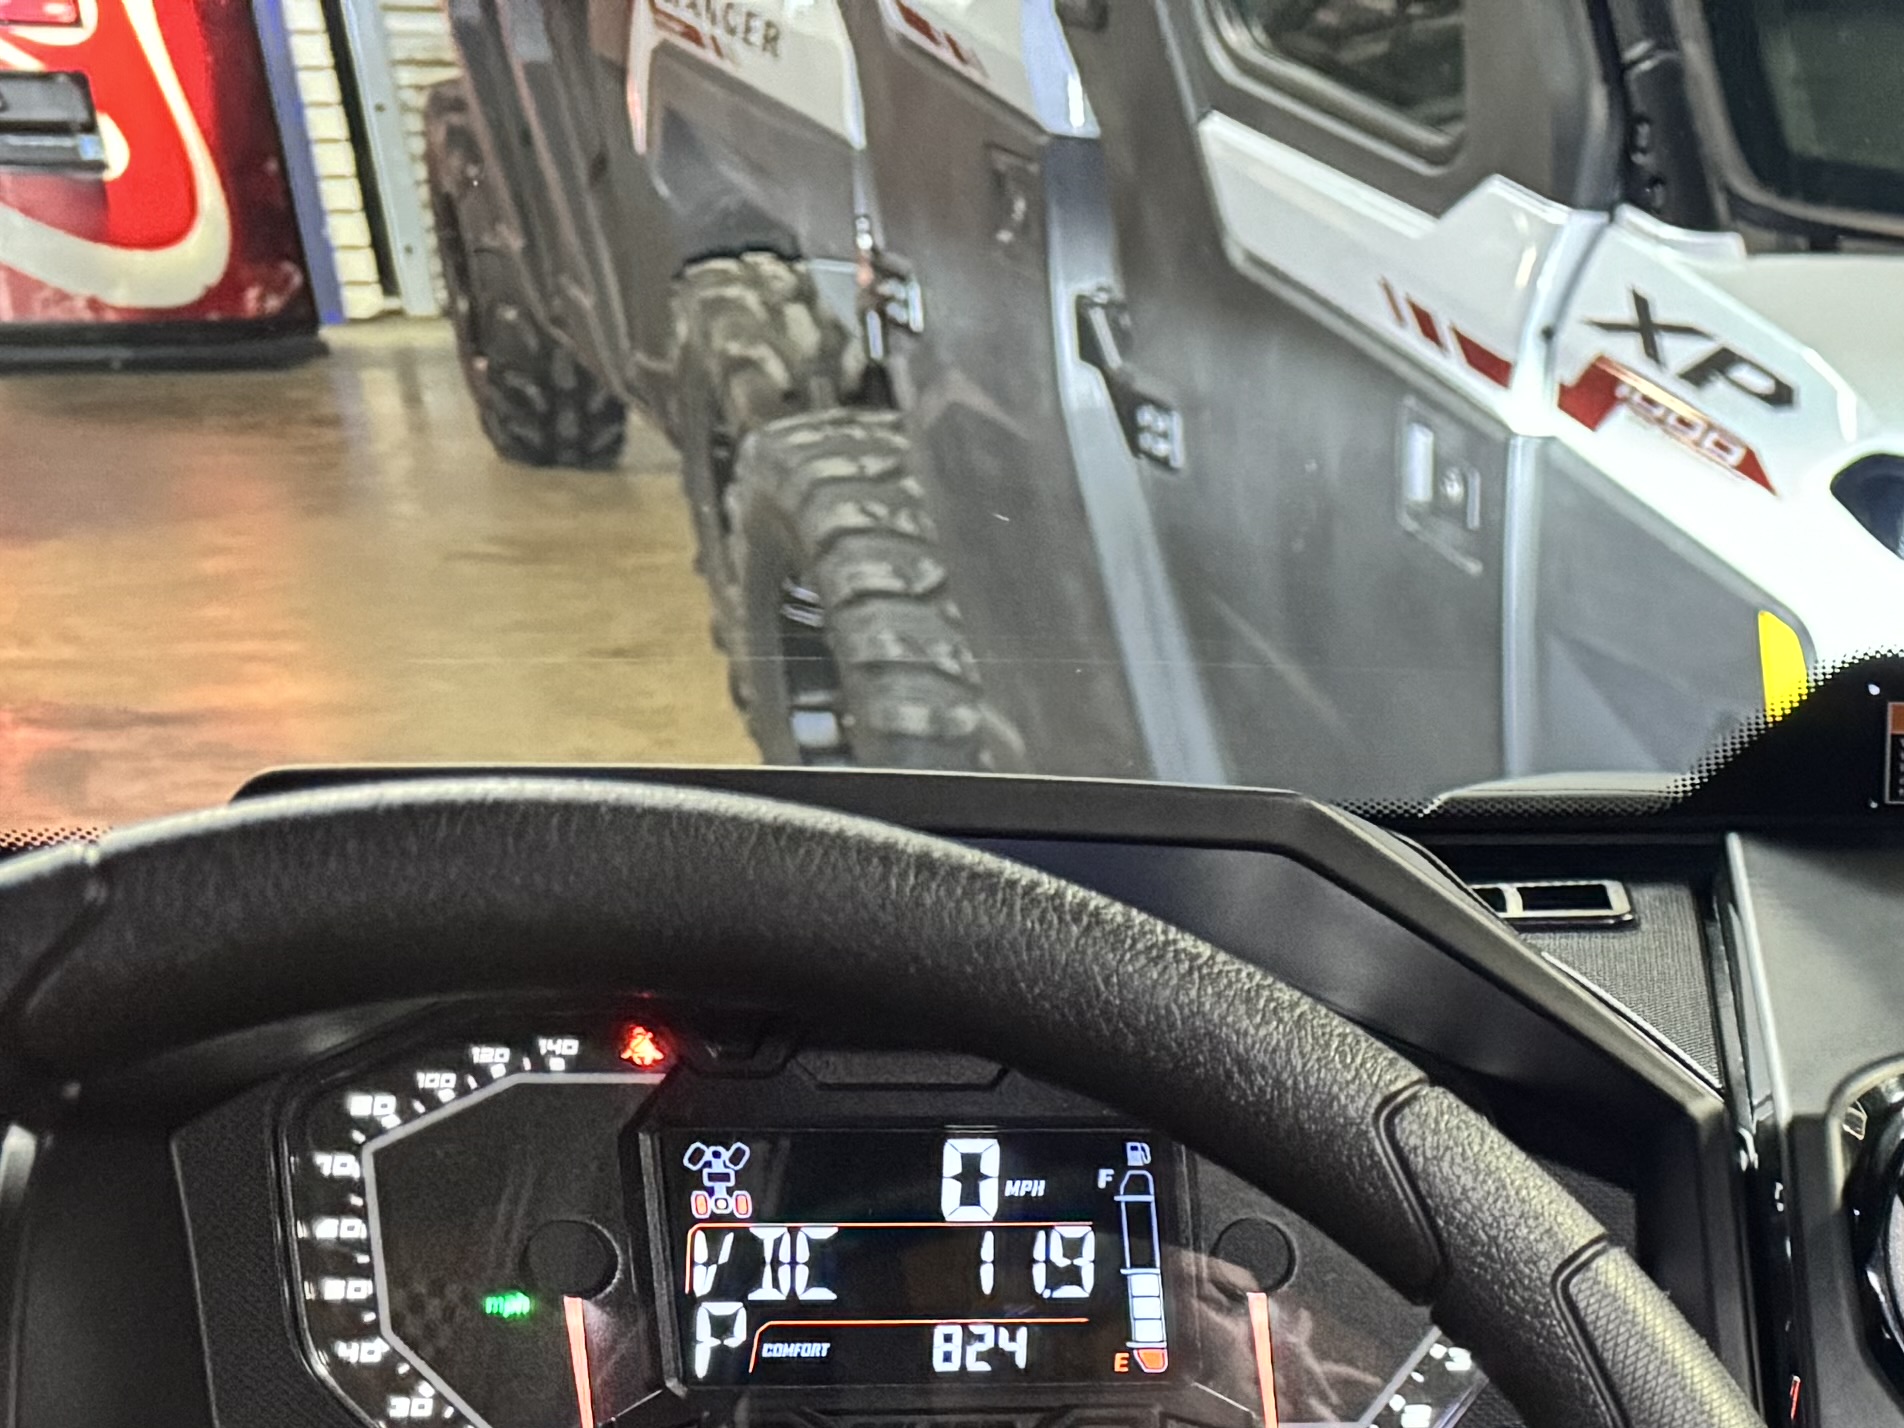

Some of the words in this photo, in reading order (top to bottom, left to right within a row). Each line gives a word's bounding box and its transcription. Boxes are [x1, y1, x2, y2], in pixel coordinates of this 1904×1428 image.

[1583, 284, 1797, 411] XP
[471, 1046, 510, 1064] 120
[538, 1038, 579, 1056] 140
[416, 1072, 457, 1089] 100
[942, 1137, 1000, 1222] 0
[1005, 1179, 1046, 1197] MPH
[1097, 1169, 1115, 1189] F
[695, 1301, 747, 1379] P
[762, 1342, 830, 1359] COMFORT
[1114, 1352, 1130, 1372] E
